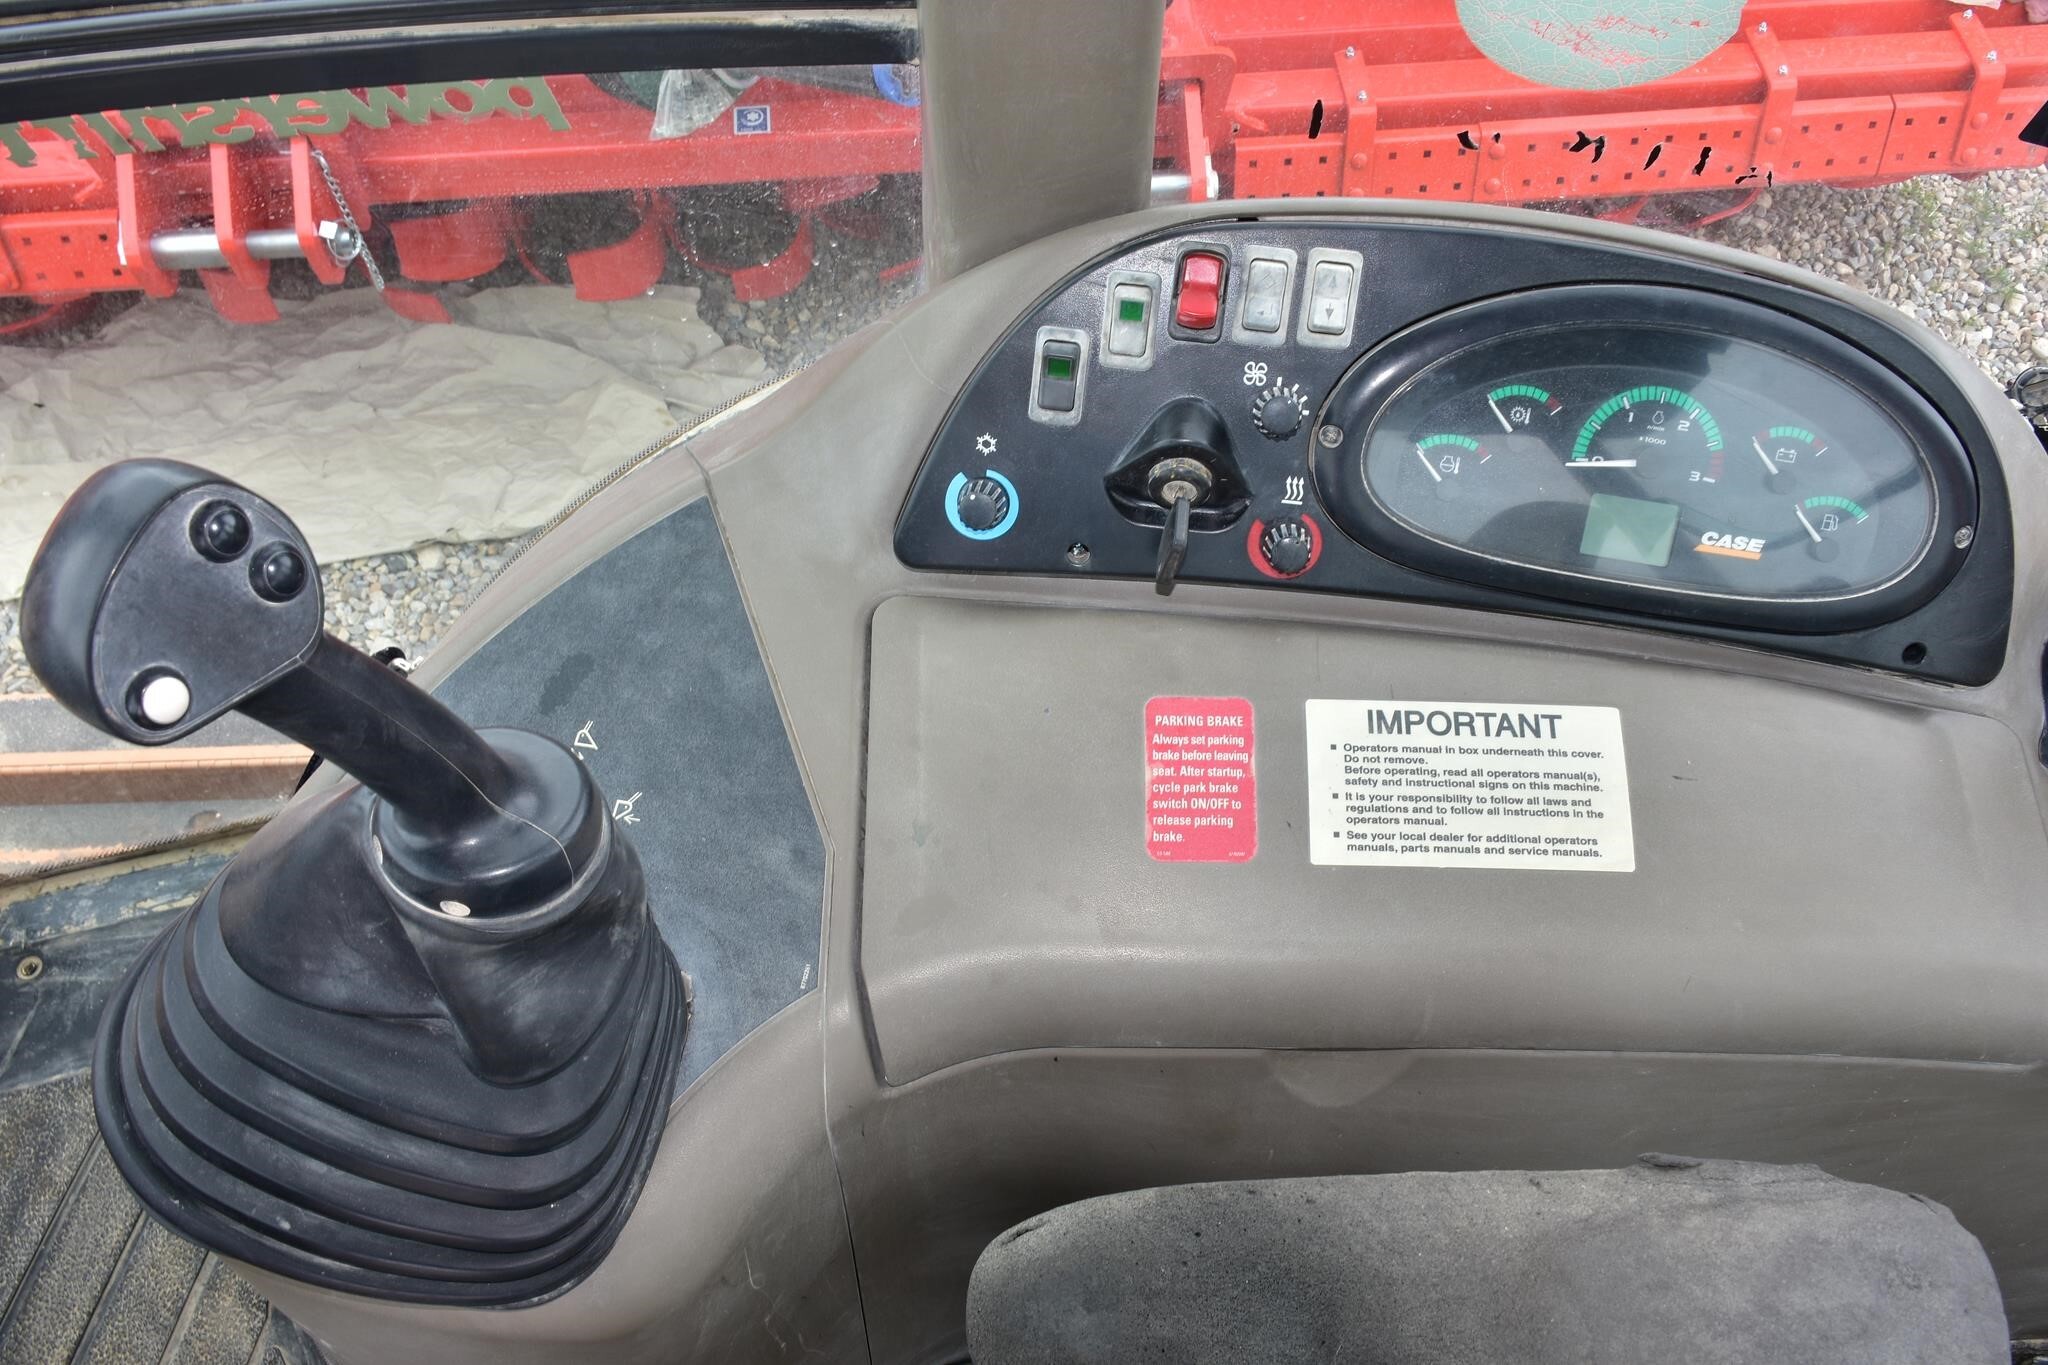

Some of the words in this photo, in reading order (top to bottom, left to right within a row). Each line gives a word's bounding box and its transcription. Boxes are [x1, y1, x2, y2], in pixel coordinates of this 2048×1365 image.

[1628, 412, 1634, 423] 1
[1678, 420, 1690, 432] 2
[1689, 471, 1700, 482] 3
[1701, 531, 1765, 552] CASE
[1155, 715, 1204, 727] PARKING
[1207, 716, 1244, 727] BRAKE
[1368, 709, 1562, 739] IMPORTANT
[1152, 734, 1189, 746] Always
[1190, 736, 1205, 745] set
[1207, 734, 1245, 747] parking
[1152, 749, 1180, 760] brake
[1182, 750, 1212, 761] before
[1214, 751, 1249, 763] leaving
[1343, 743, 1398, 754] Operators
[1402, 745, 1442, 754] manual
[1445, 746, 1455, 754] in
[1459, 746, 1479, 755] box
[1482, 747, 1544, 757] underneath
[1547, 749, 1568, 757] this
[1571, 751, 1604, 759] cover.
[1344, 754, 1359, 763] Do
[1362, 755, 1381, 764] not
[1384, 757, 1428, 765] remove.
[1152, 767, 1177, 776] seat.
[1179, 766, 1205, 777] After
[1207, 767, 1245, 779] startup,
[1344, 766, 1381, 775] Before
[1384, 767, 1440, 778] operating,
[1443, 768, 1467, 777] read
[1471, 769, 1484, 777] all
[1486, 770, 1540, 779] operators
[1543, 771, 1601, 782] manual(s),
[1152, 781, 1181, 795] cycle
[1183, 782, 1207, 795] park
[1209, 782, 1239, 793] brake
[1345, 777, 1378, 788] safety
[1382, 778, 1402, 786] and
[1406, 779, 1475, 788] instructional
[1479, 780, 1509, 791] signs
[1512, 782, 1526, 790] on
[1529, 782, 1550, 791] this
[1553, 783, 1603, 792] machine.
[1153, 797, 1188, 809] switch
[1191, 798, 1229, 810] ON/OFF
[1231, 799, 1242, 809] to
[1345, 792, 1352, 800] It
[1356, 792, 1365, 801] is
[1368, 794, 1394, 802] your
[1397, 794, 1473, 805] responsibility
[1476, 795, 1487, 804] to
[1490, 795, 1523, 805] follow
[1527, 796, 1539, 805] all
[1543, 797, 1567, 806] laws
[1571, 798, 1592, 807] and
[1346, 804, 1409, 814] regulations
[1412, 805, 1433, 814] and
[1436, 806, 1447, 814] to
[1450, 806, 1483, 815] follow
[1487, 807, 1500, 816] all
[1503, 808, 1570, 818] instructions
[1573, 809, 1583, 818] in
[1586, 810, 1604, 819] the
[1153, 814, 1192, 825] release
[1194, 815, 1234, 828] parking
[1346, 815, 1400, 826] operators
[1404, 817, 1447, 826] manual.
[1153, 830, 1185, 842] brake.
[1347, 831, 1368, 840] See
[1371, 833, 1396, 842] your
[1400, 832, 1426, 841] local
[1429, 833, 1464, 842] dealer
[1467, 833, 1483, 842] for
[1486, 834, 1541, 844] additional
[1544, 836, 1598, 846] operators
[1347, 843, 1398, 853] manuals,
[1401, 845, 1430, 854] parts
[1434, 845, 1481, 854] manuals
[1484, 846, 1505, 855] and
[1508, 847, 1549, 856] service
[1552, 848, 1602, 857] manuals.
